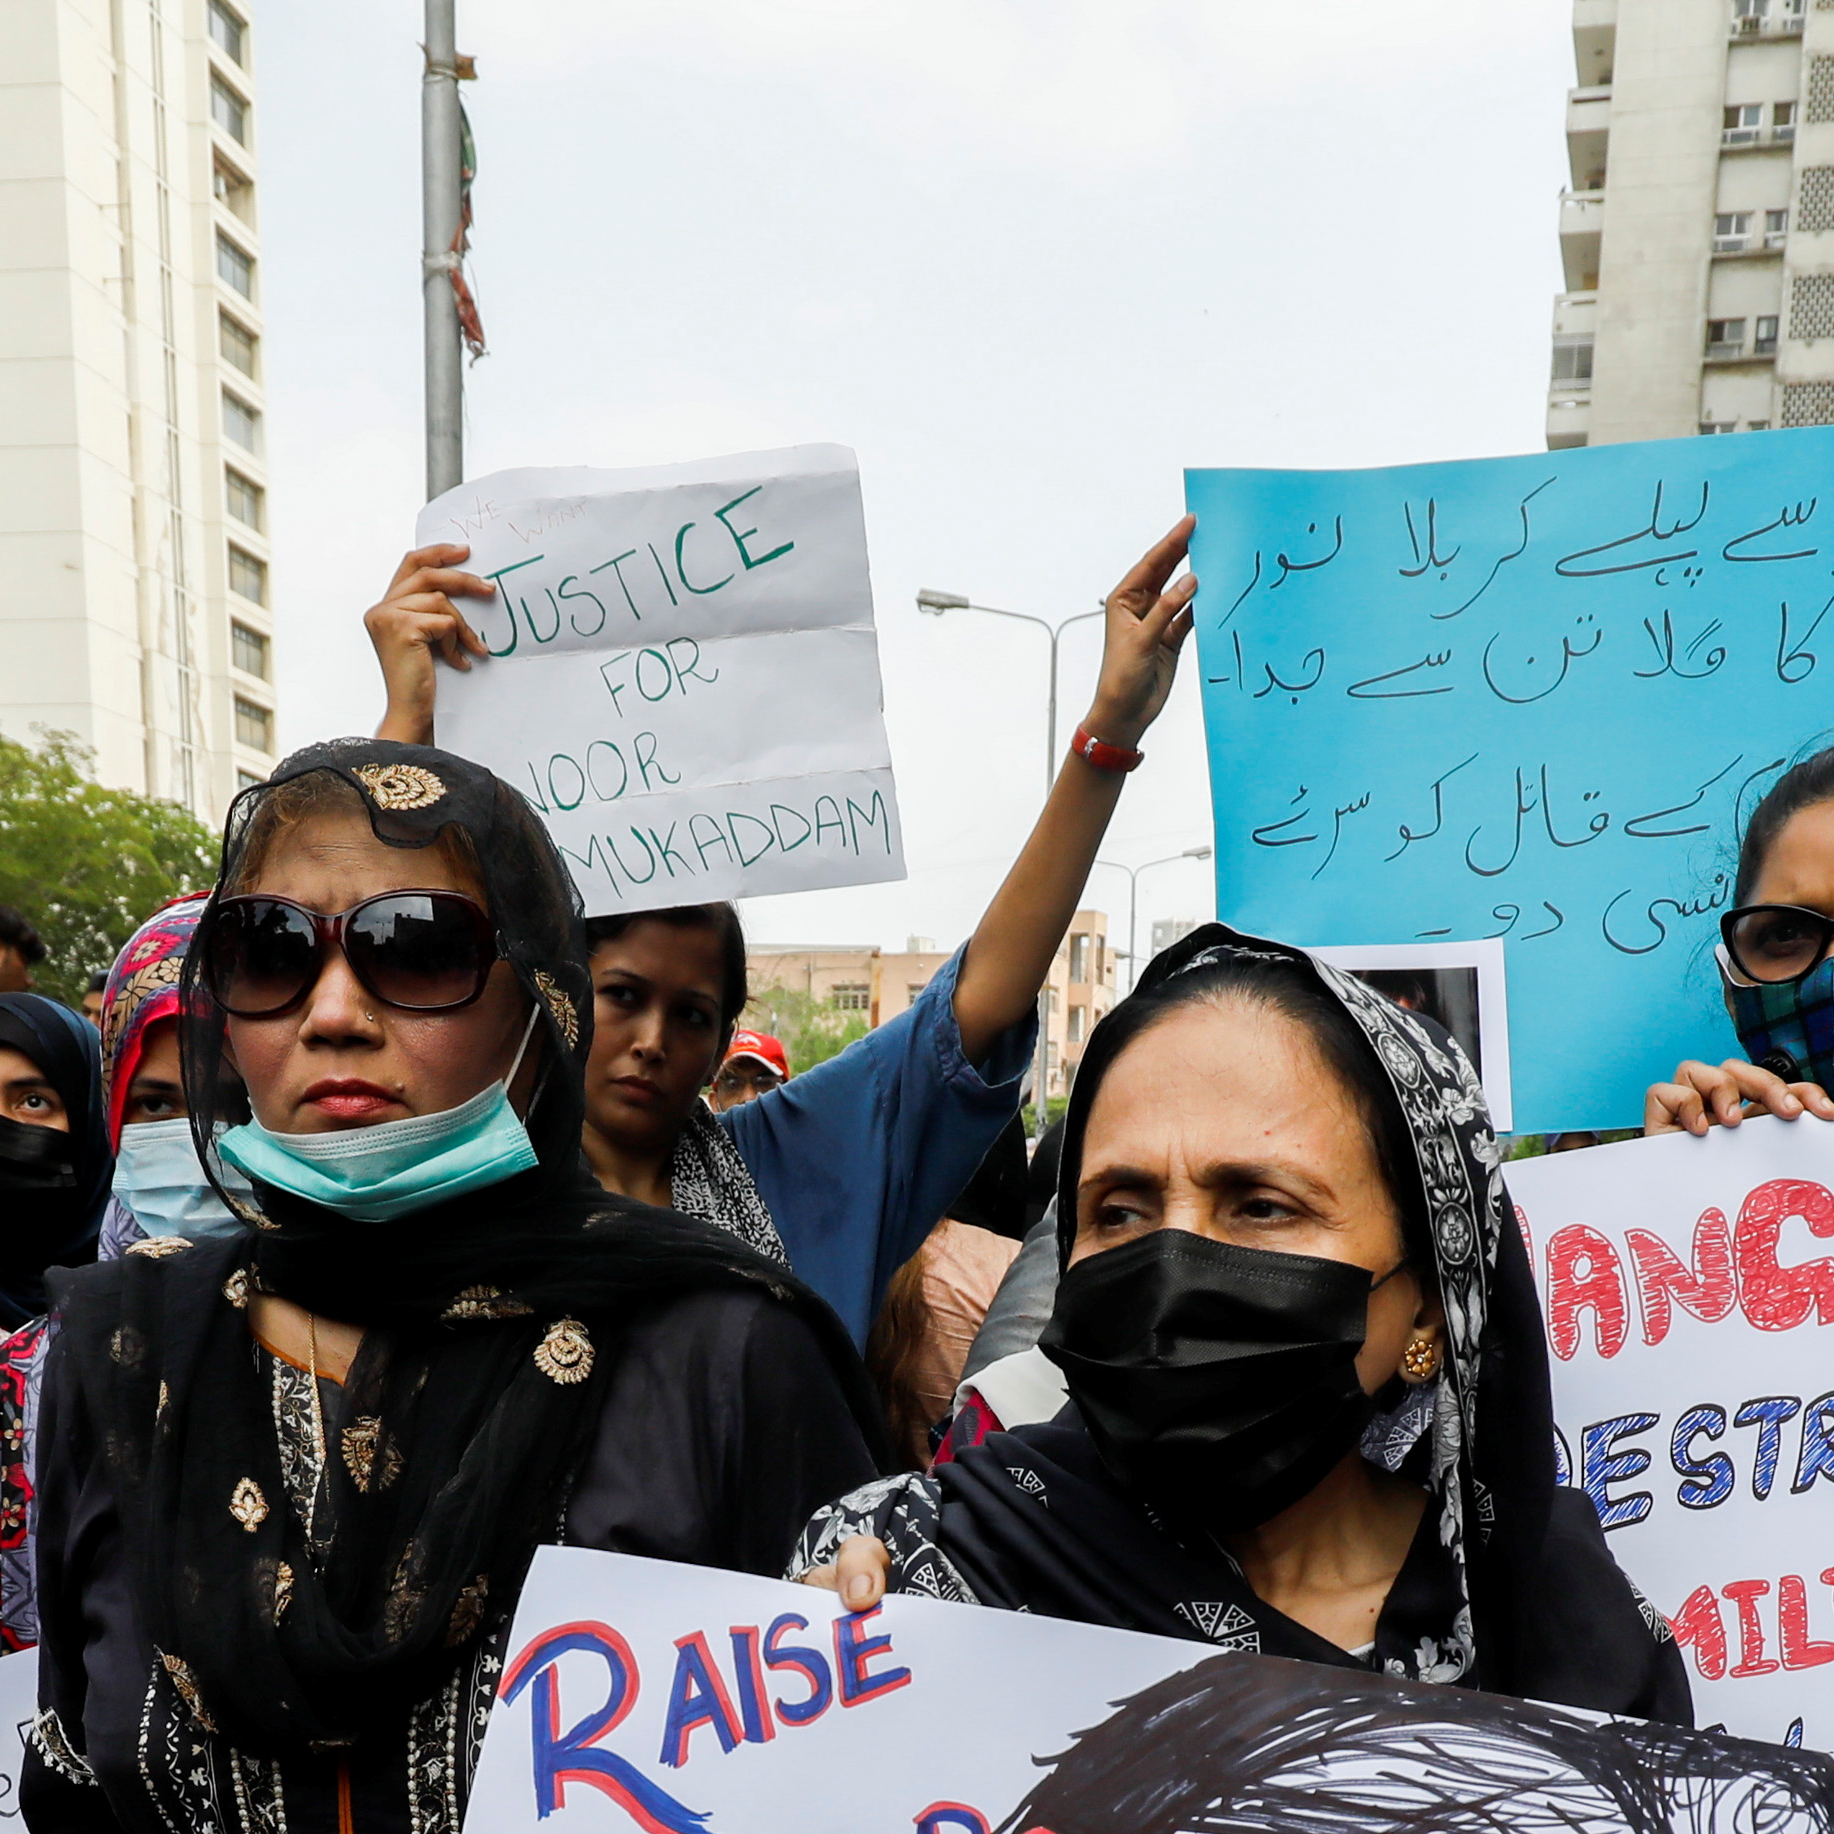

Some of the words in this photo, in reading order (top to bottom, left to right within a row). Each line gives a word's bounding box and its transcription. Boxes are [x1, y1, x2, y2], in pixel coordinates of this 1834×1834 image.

[481, 484, 795, 657] JUSTICE
[599, 636, 719, 717] FOR
[520, 732, 682, 816] NOOR
[558, 790, 892, 899] MUKADDAM
